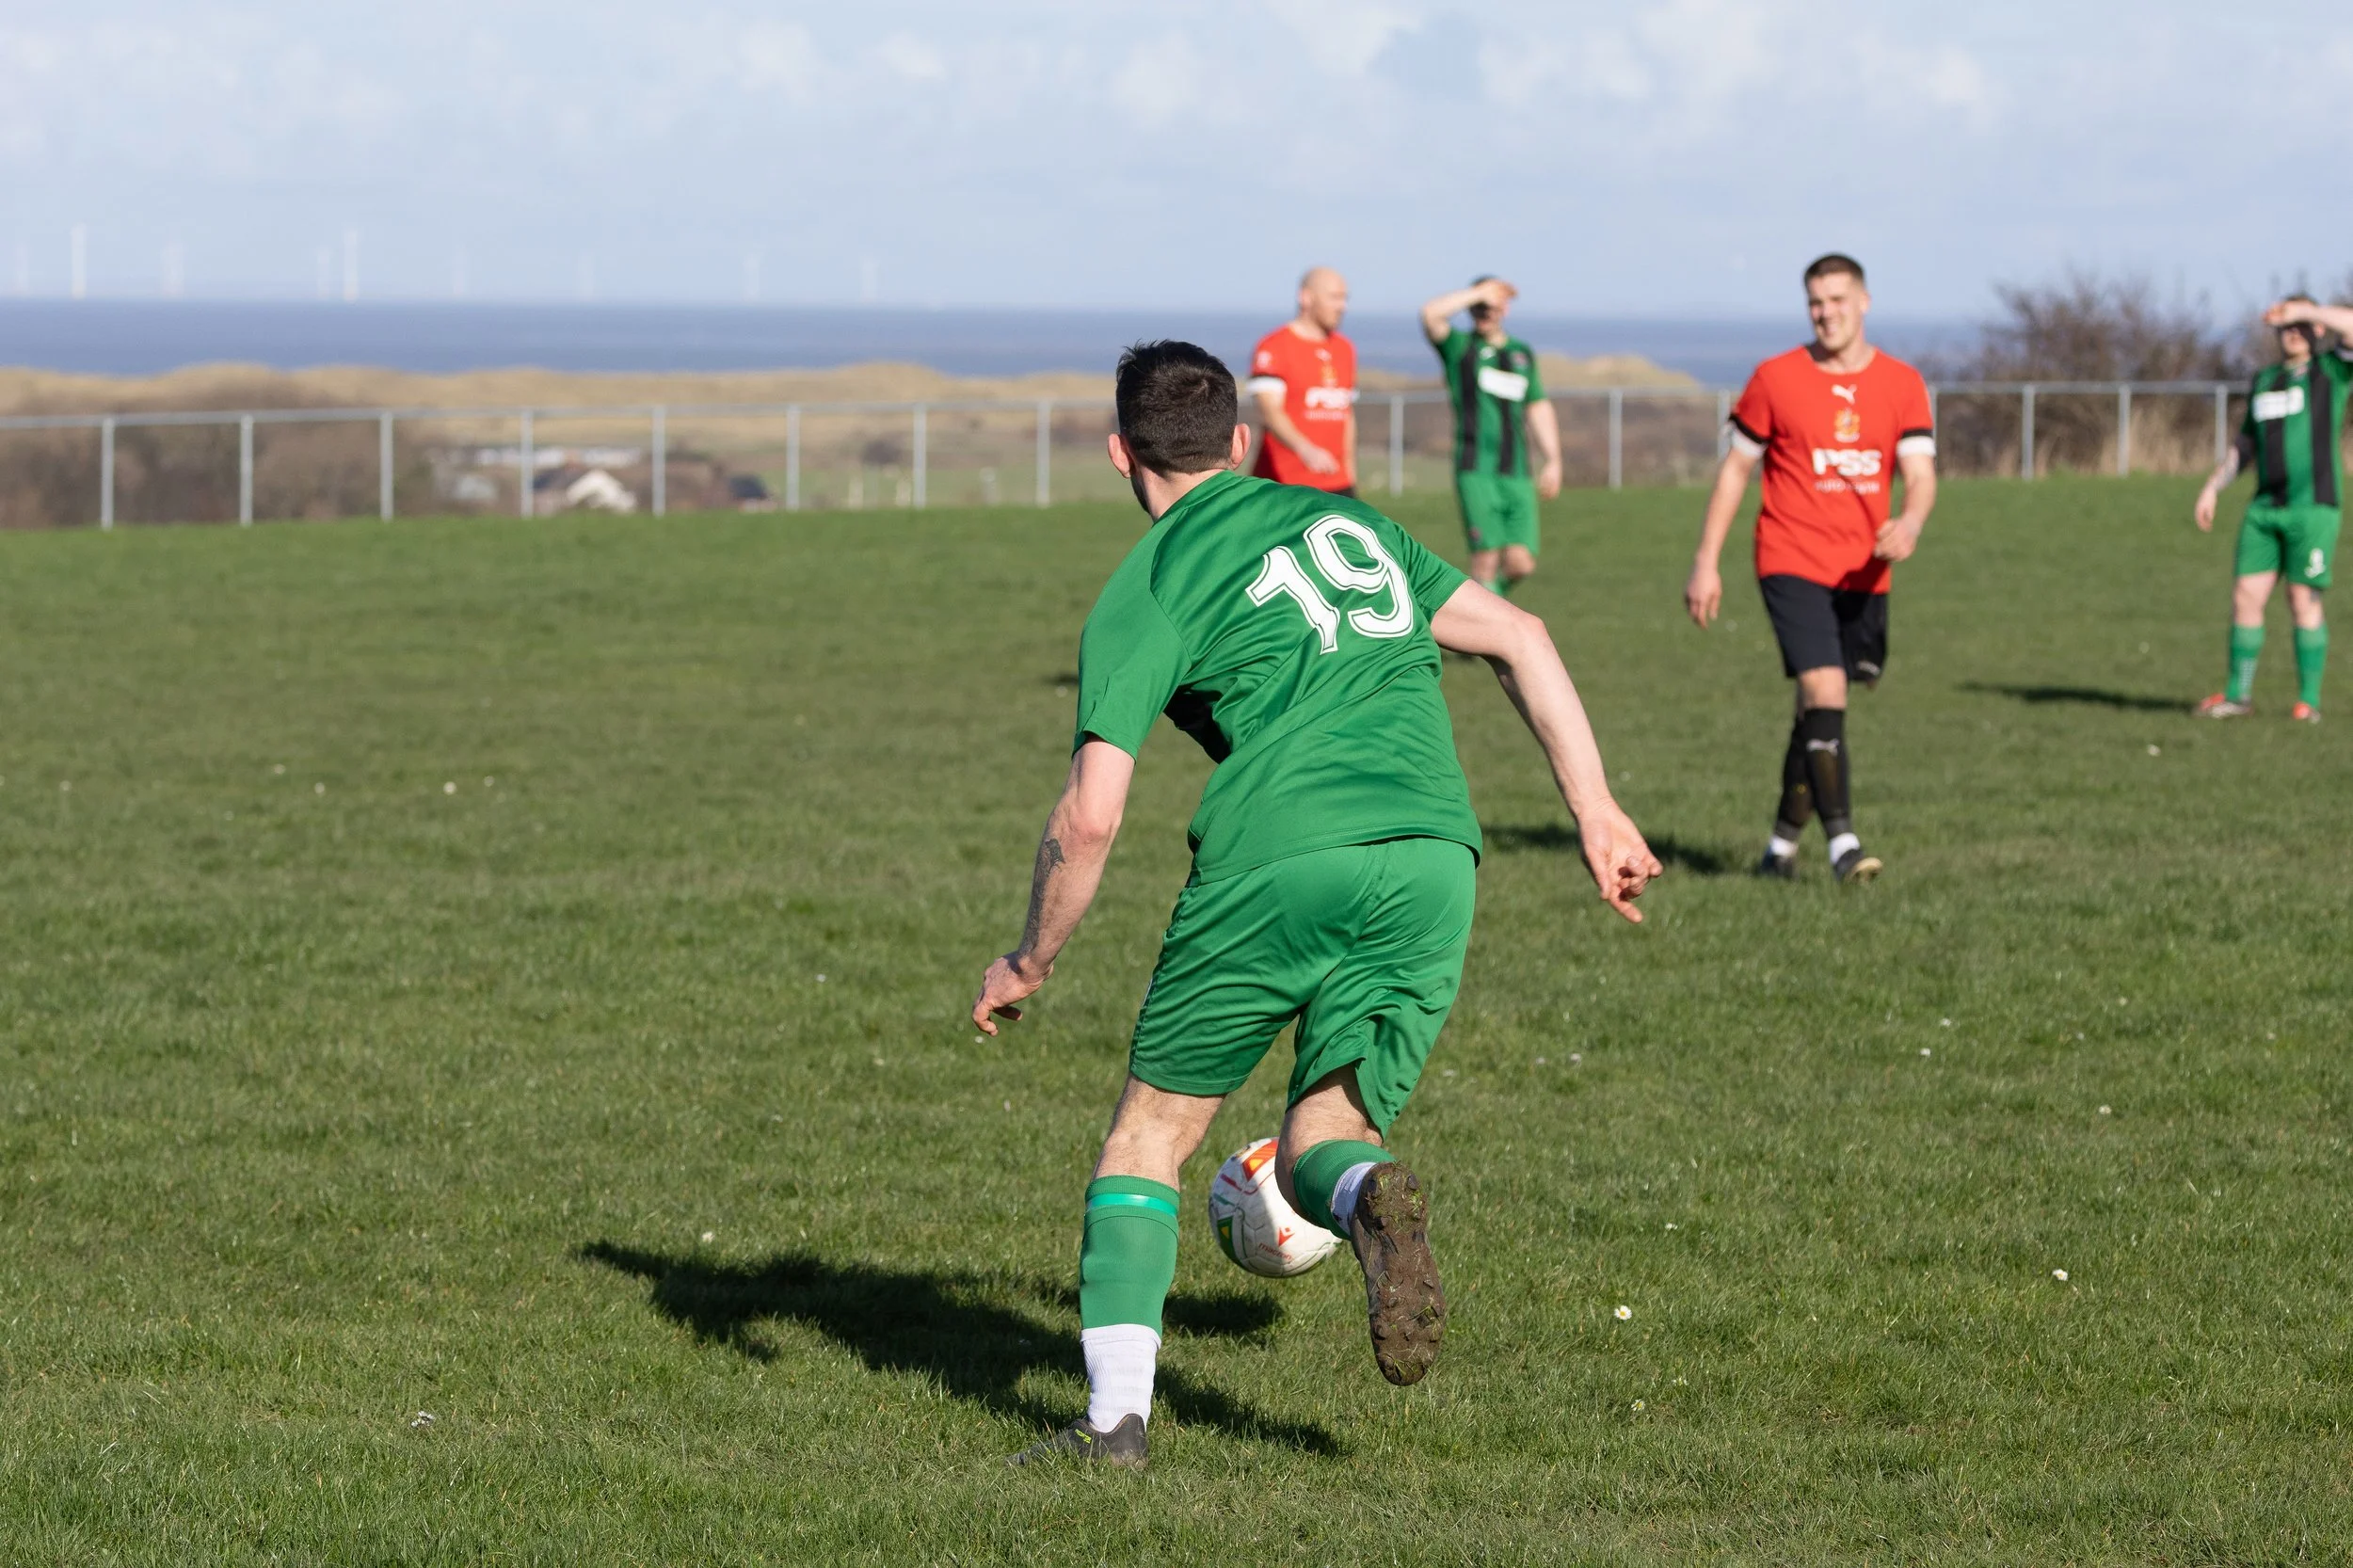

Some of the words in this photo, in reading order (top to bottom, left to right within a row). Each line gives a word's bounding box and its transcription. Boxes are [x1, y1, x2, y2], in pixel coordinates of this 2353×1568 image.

[1813, 448, 1881, 476] PSS
[1245, 515, 1414, 655] 19
[1258, 1243, 1292, 1260] macron
